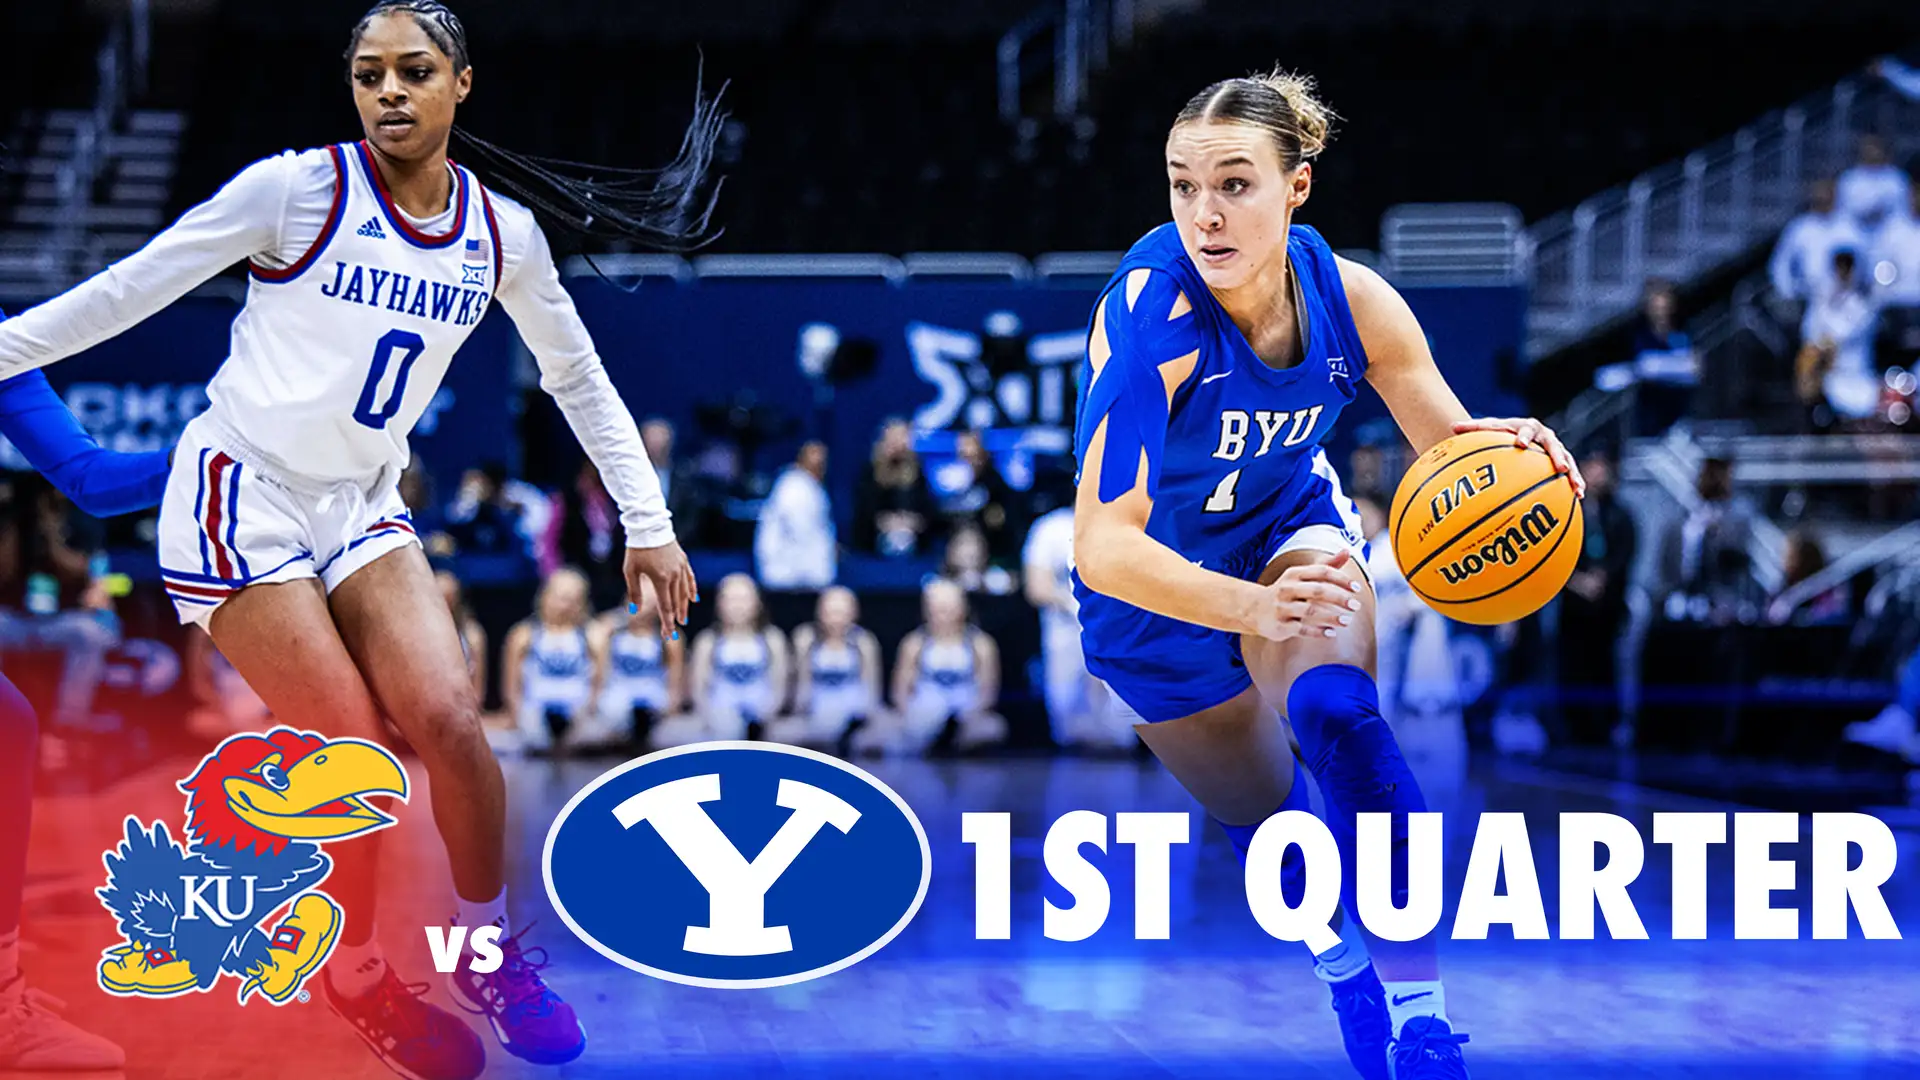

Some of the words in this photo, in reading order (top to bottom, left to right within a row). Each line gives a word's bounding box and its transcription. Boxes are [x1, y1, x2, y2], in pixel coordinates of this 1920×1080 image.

[356, 227, 387, 240] adidas
[321, 261, 489, 326] JAYHAWKS
[352, 328, 426, 430] 0
[1210, 404, 1325, 462] BYU
[1203, 467, 1243, 513] 1
[1429, 463, 1498, 525] EVO
[1438, 502, 1560, 585] Wilson
